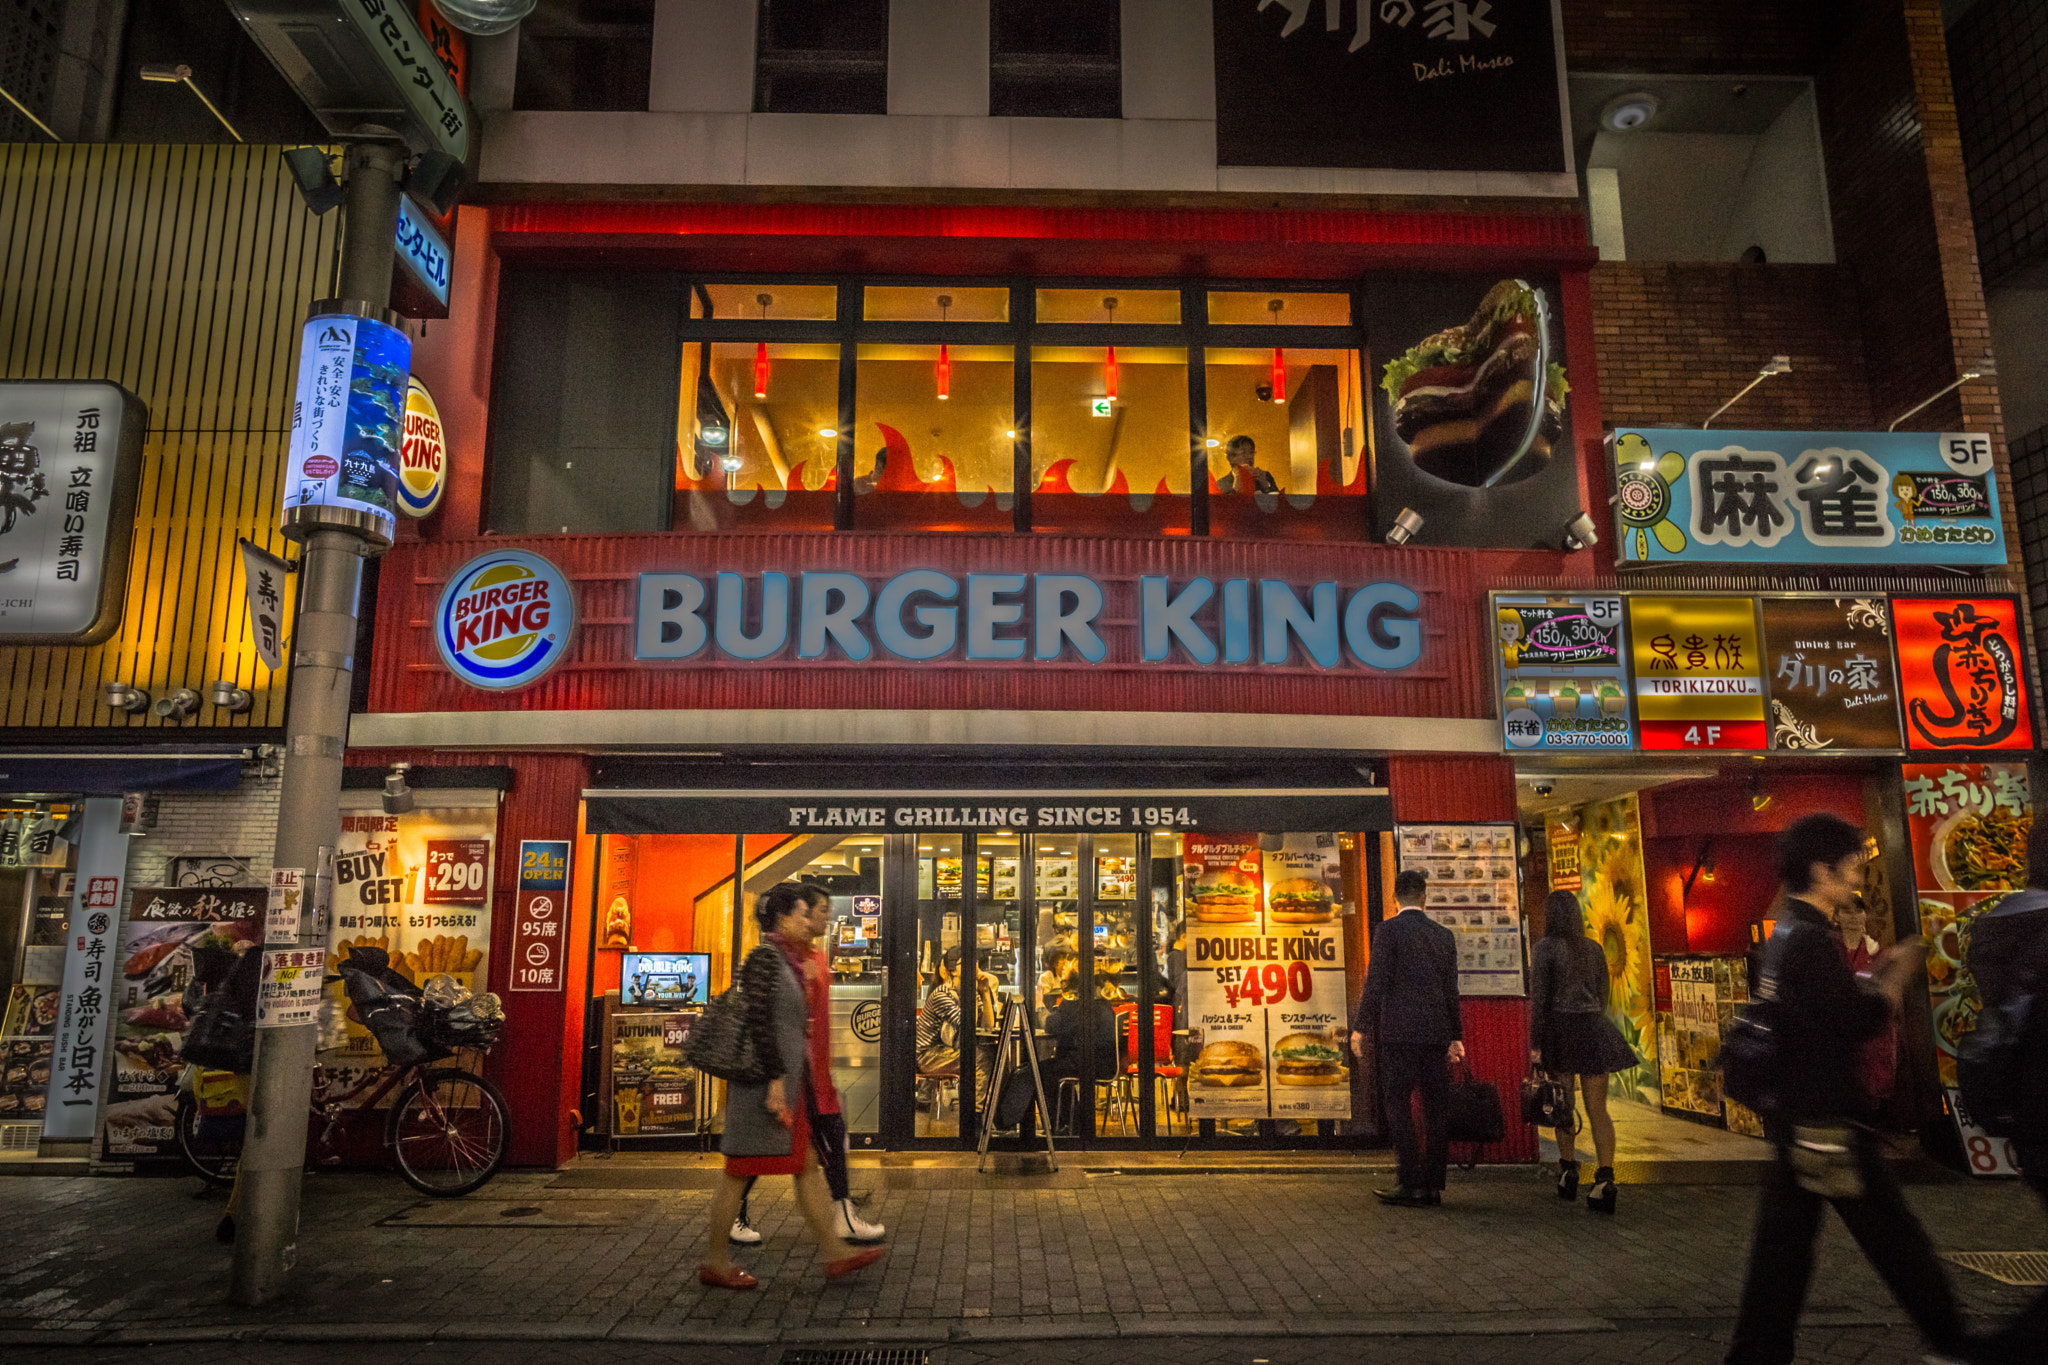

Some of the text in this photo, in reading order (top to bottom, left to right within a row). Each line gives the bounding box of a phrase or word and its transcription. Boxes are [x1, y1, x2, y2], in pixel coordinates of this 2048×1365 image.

[1413, 54, 1514, 81] Dali Museo
[327, 356, 346, 408] 安全・安心
[311, 364, 329, 452] きれいな街づくり
[401, 438, 441, 473] KING
[1949, 440, 1988, 465] 5F
[56, 408, 101, 582] 元祖 立喰い寿司
[1699, 455, 1885, 537] 麻雀
[1931, 489, 1957, 502] 150/h
[454, 579, 550, 624] BURGER
[1592, 601, 1619, 619] 5F
[257, 569, 279, 659] 寿司
[634, 569, 1421, 670] BURGER KING
[1519, 609, 1555, 618] セット料金
[454, 600, 552, 655] KING
[1536, 625, 1607, 647] 150/h 300/h
[1795, 640, 1857, 649] Dining Bar
[1550, 648, 1602, 662] フリードリンク
[1777, 652, 1880, 697] ダリの家
[1651, 680, 1747, 693] TORIKIZOKU
[1844, 693, 1888, 709] Dali Museo
[1507, 720, 1541, 736] 麻雀
[1547, 734, 1629, 746] 03-3770-0001
[1904, 768, 2031, 818] 赤ちり亭
[341, 815, 398, 833] 期間限定
[789, 807, 1198, 826] FLAME GRILLING SINCE 1954.
[429, 851, 454, 864] 2つで
[1272, 852, 1328, 862] ダブルバーベキュー
[336, 852, 386, 885] BUY
[428, 862, 484, 891] ¥290
[523, 869, 564, 880] OPEN
[360, 878, 404, 906] GET
[142, 893, 256, 921] 食欲の秋を握る
[522, 922, 558, 937] 95席
[1195, 937, 1336, 961] DOUBLE KING
[280, 969, 298, 980] No!
[519, 968, 554, 984] 10席
[638, 960, 692, 973] DOUBLE KING
[1216, 966, 1241, 983] SET
[1671, 964, 1714, 983] 飲み放題
[1224, 961, 1312, 1009] ¥490
[62, 937, 107, 1107] 寿司 魚がし日本一
[856, 1009, 881, 1023] BURGE
[1280, 1013, 1337, 1023] モンスターベイビー
[57, 994, 74, 1072] STANDING SUSHI BAR
[617, 1025, 662, 1038] AUTUMN
[653, 1093, 682, 1106] FREE!
